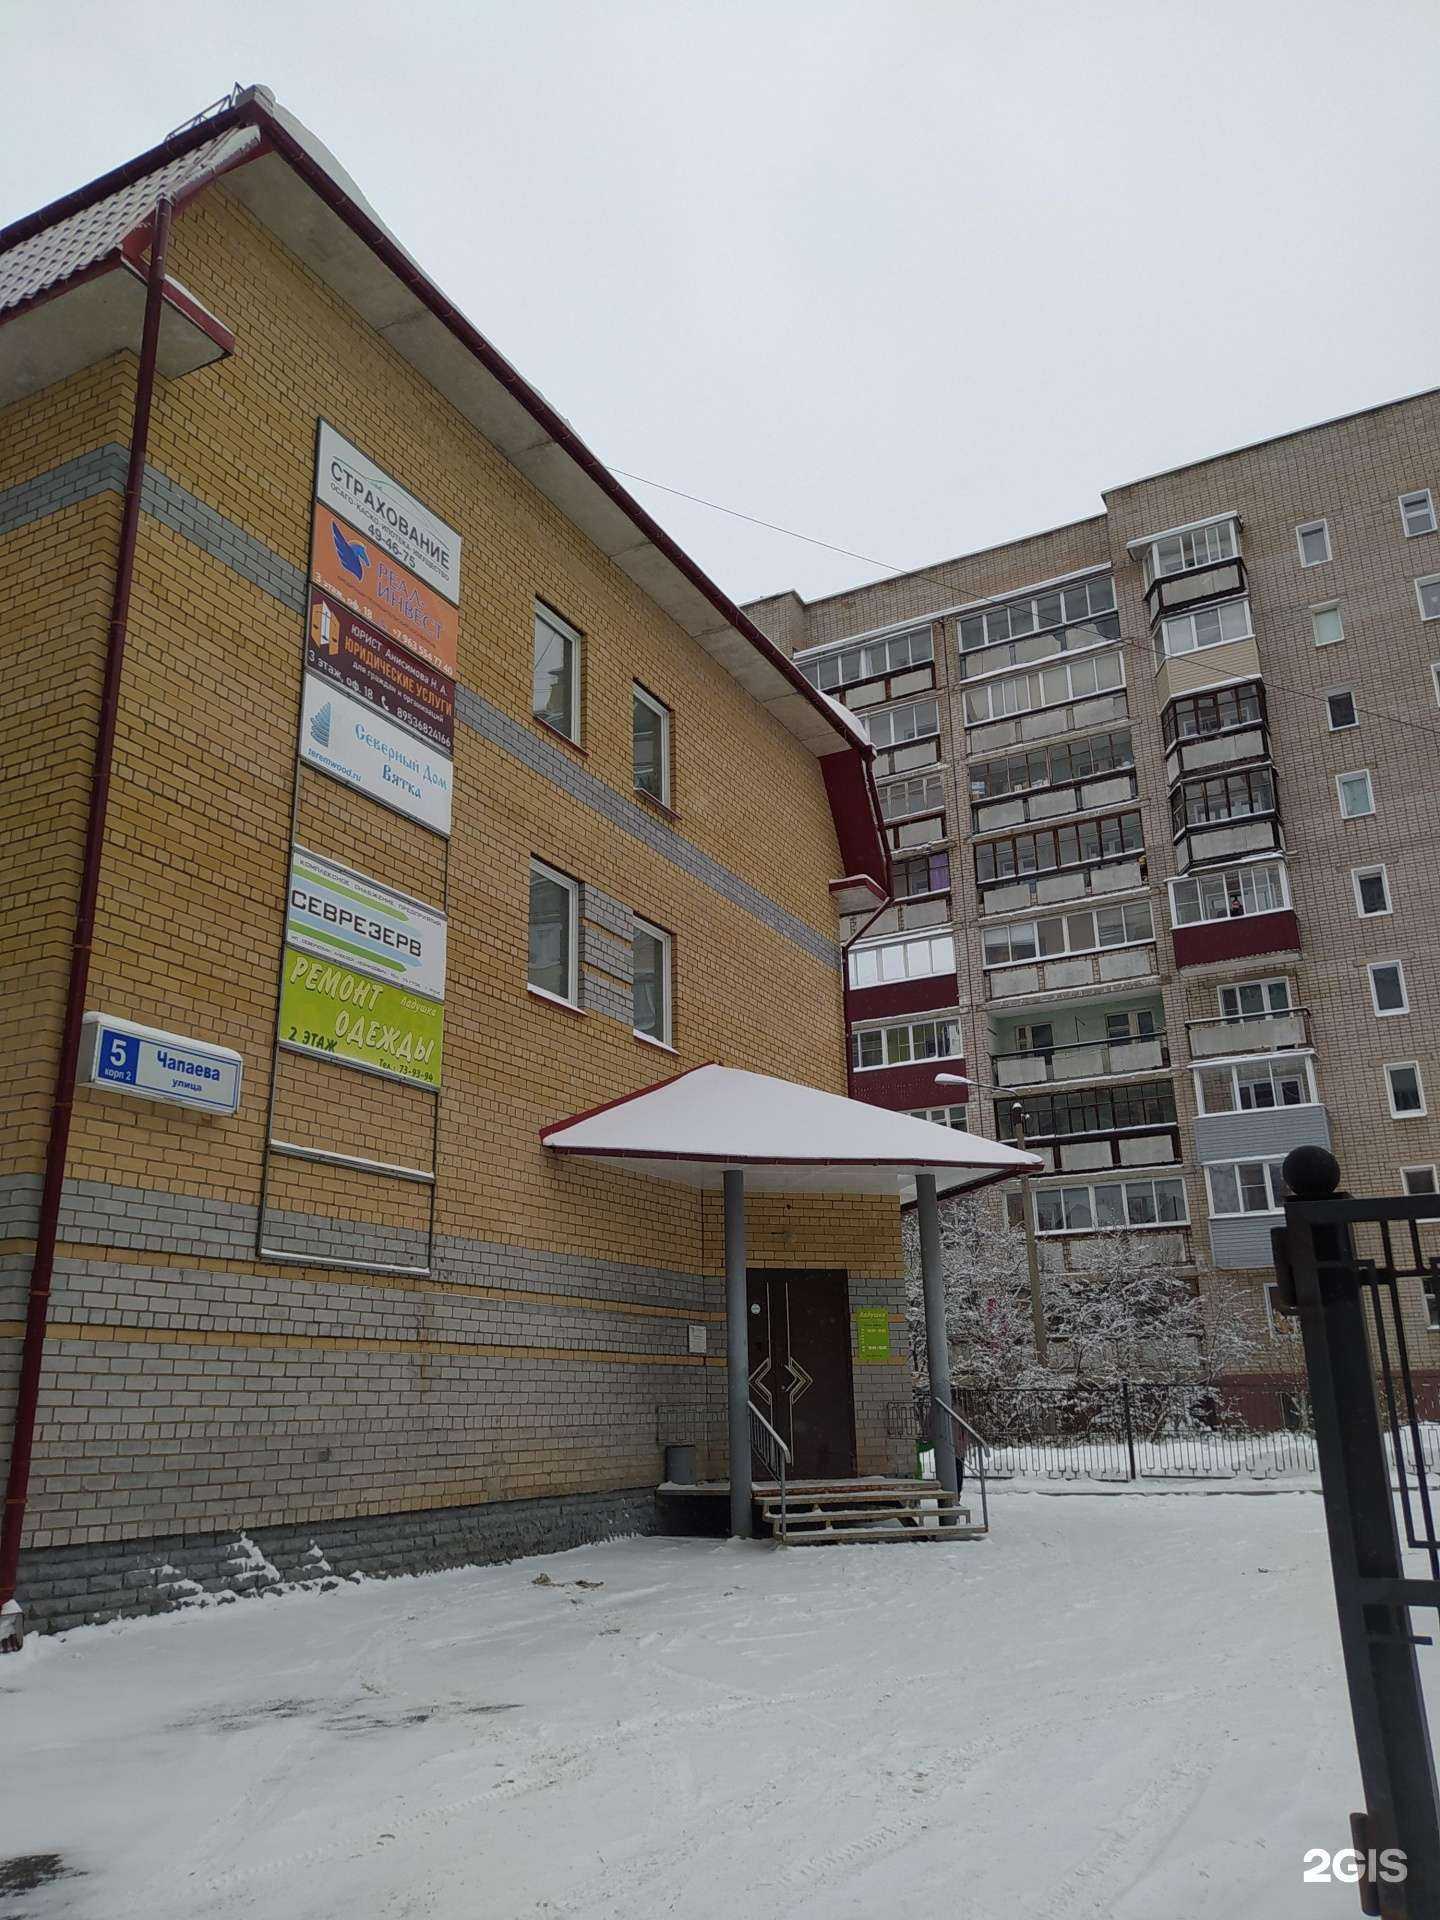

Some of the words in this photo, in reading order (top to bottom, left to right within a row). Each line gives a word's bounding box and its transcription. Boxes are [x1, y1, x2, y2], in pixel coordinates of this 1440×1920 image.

[331, 461, 450, 570] СТРАХОВАНИЕ
[367, 524, 416, 569] 49-46-75
[308, 649, 315, 662] 3
[363, 685, 374, 700] 18
[344, 636, 414, 693] ЮРИДИЧЕСКИЕ
[415, 683, 452, 716] УСЛУГИ
[351, 624, 382, 651] ЮРИСТ
[385, 648, 429, 683] Анисимова
[307, 747, 362, 783] teremwood.ru
[355, 723, 420, 771] Северный
[422, 762, 449, 791] Дом
[382, 763, 423, 799] Вятка
[291, 889, 422, 957] СЕВРЕЗЕРВ
[290, 956, 384, 1011] РЕМОНТ
[110, 1038, 128, 1067] 5
[288, 1027, 297, 1041] 2
[302, 1030, 338, 1053] ЭТАЖ
[335, 1009, 435, 1064] ОДЕЖДЫ
[126, 1071, 132, 1081] 2
[156, 1050, 221, 1081] Чапаева
[171, 1078, 203, 1092] улица
